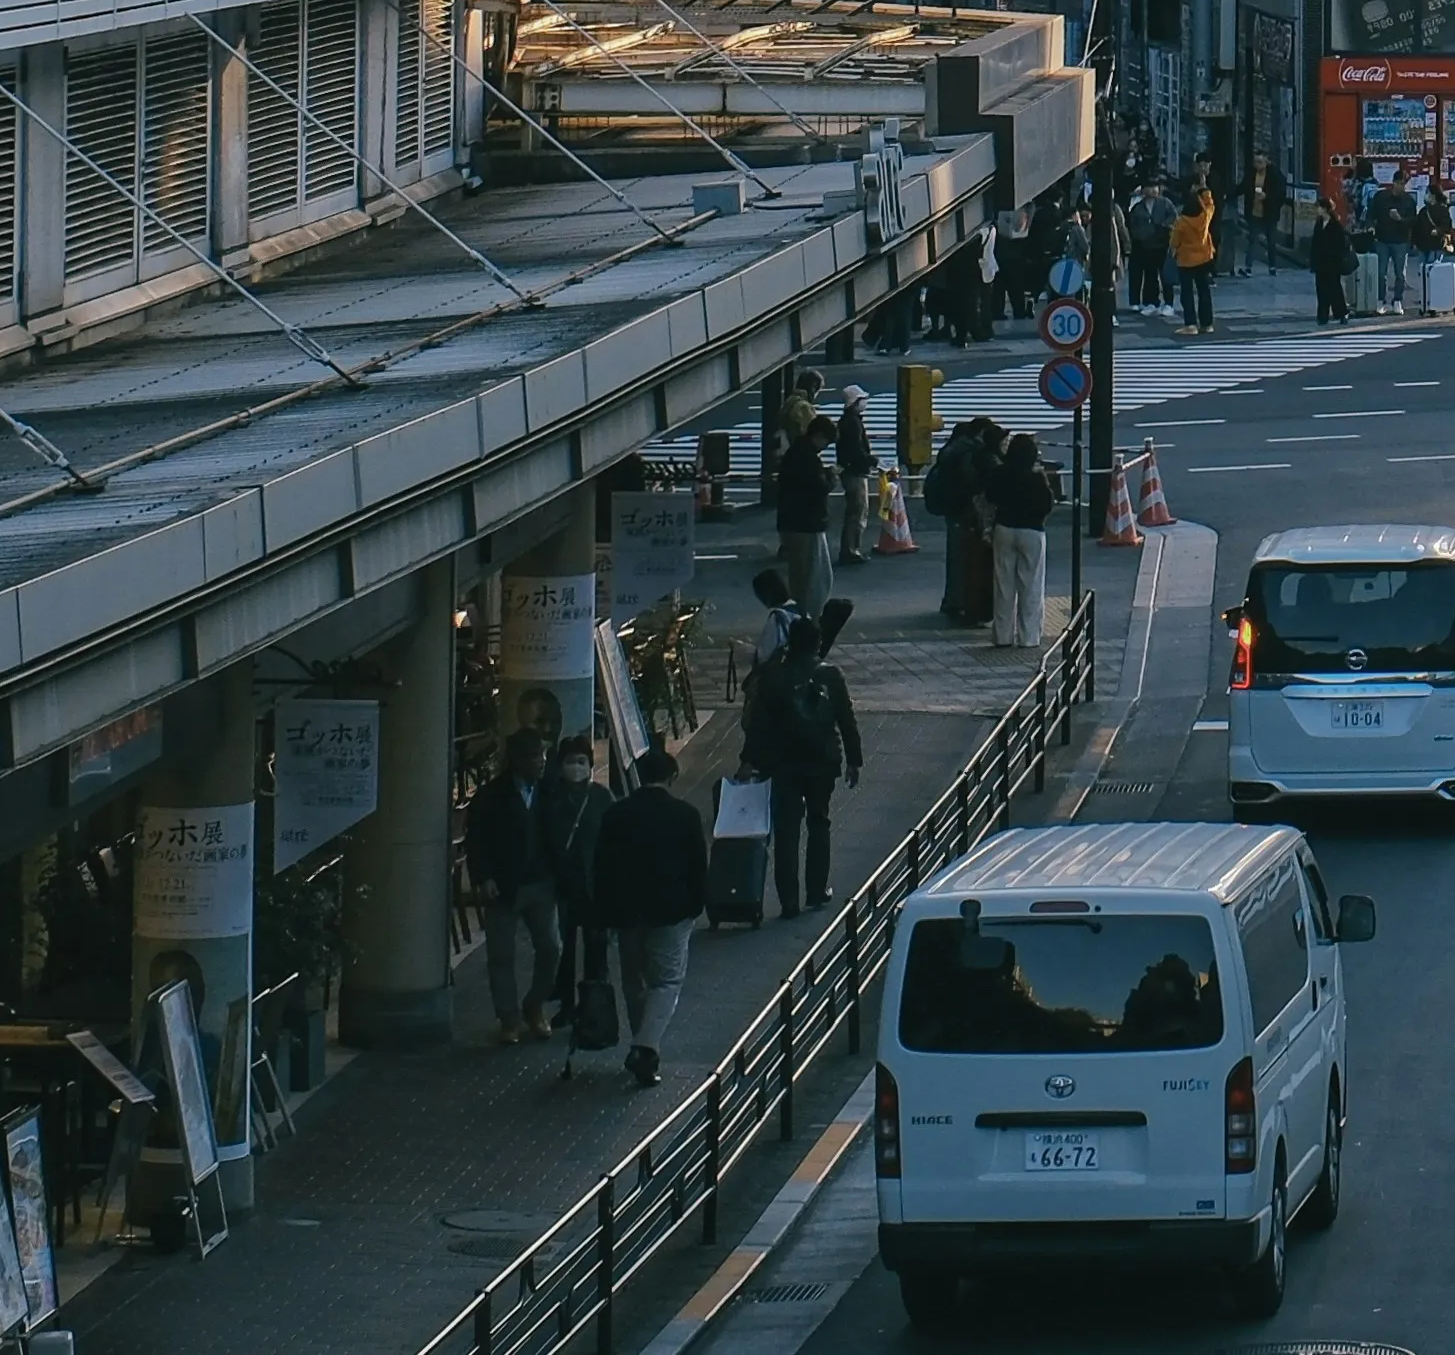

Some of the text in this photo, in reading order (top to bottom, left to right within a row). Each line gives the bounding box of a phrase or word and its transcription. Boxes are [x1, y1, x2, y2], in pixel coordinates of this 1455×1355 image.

[1052, 313, 1081, 338] 30
[911, 1114, 954, 1125] HIACE
[1040, 1146, 1097, 1167] 66-72
